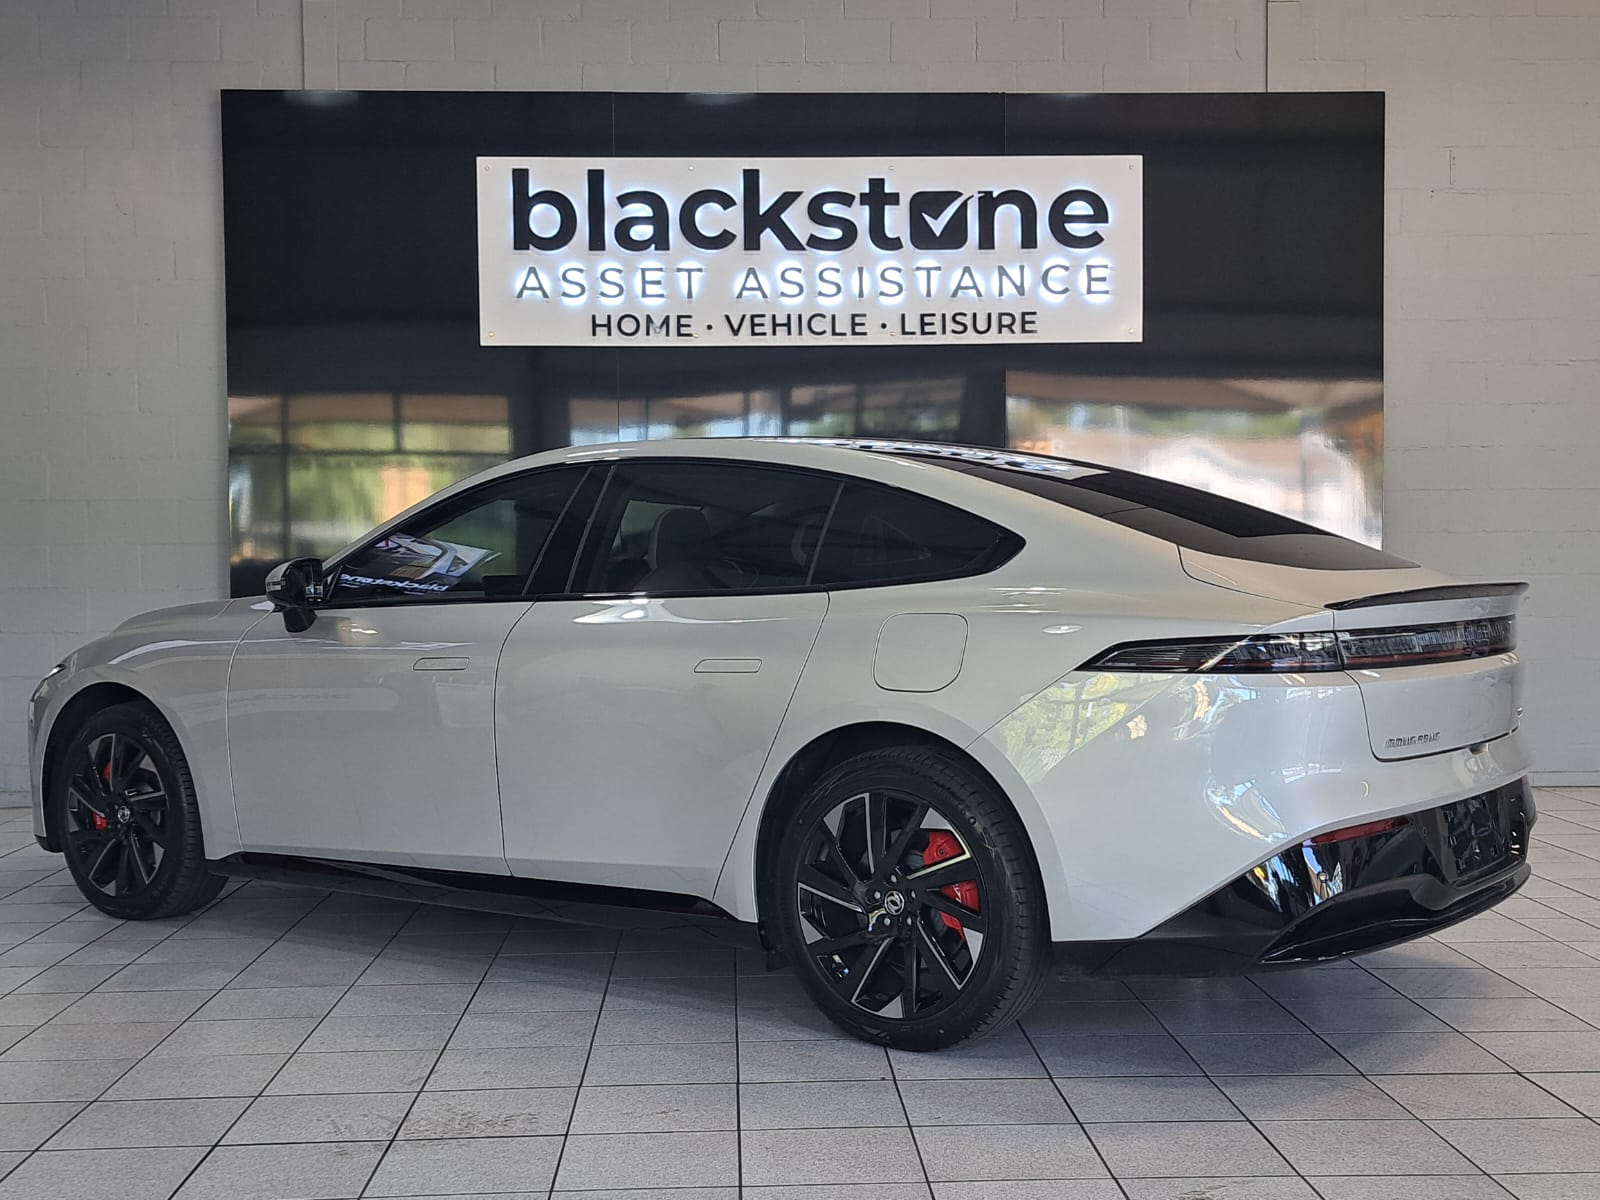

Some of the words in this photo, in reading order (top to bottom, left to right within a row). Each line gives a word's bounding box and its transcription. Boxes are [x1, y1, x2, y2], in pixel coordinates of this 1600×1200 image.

[515, 265, 704, 299] ASSET
[735, 264, 1111, 299] ASSISTANCE
[591, 313, 693, 337] HOME
[724, 312, 868, 337] VEHICLE
[900, 311, 1038, 336] LEISURE
